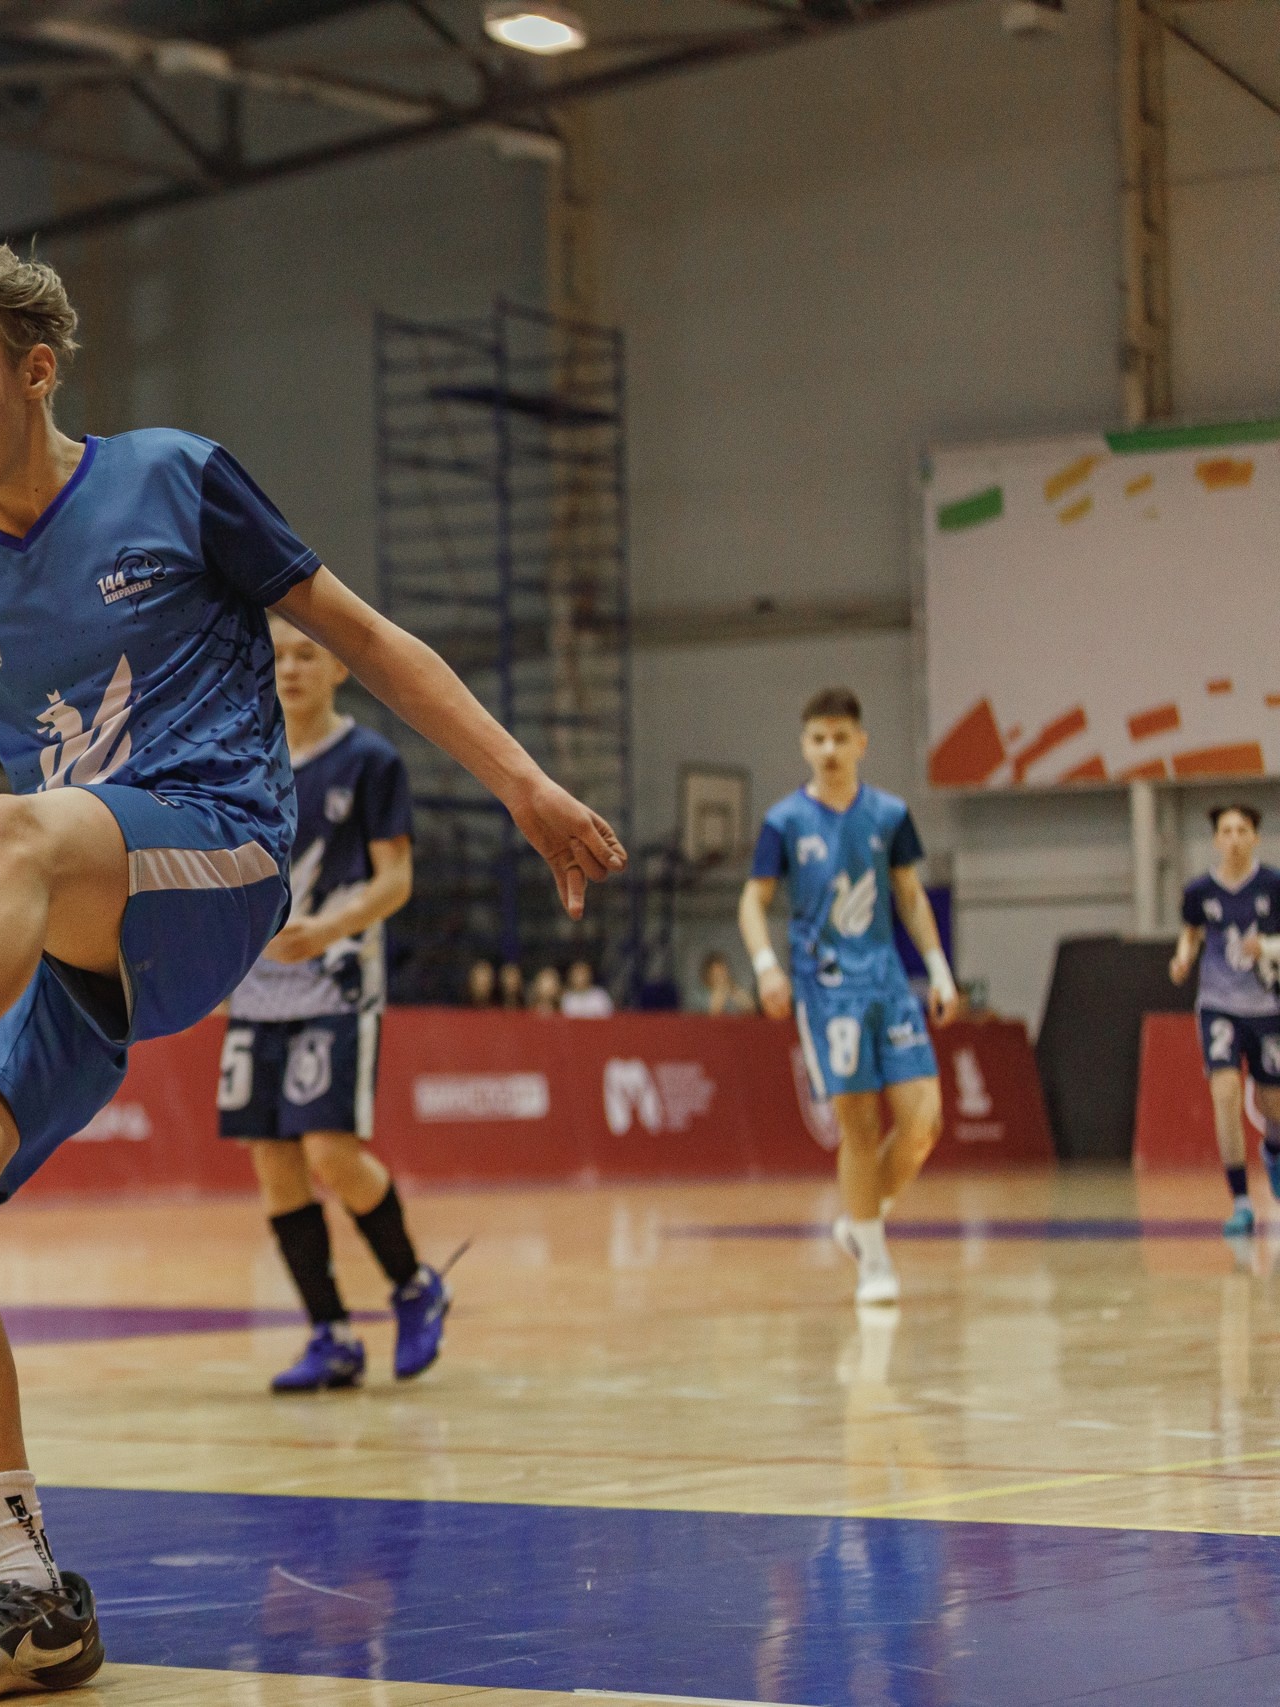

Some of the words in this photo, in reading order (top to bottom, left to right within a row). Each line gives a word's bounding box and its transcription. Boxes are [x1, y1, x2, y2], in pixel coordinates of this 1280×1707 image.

[97, 572, 126, 595] 144
[105, 580, 152, 605] ПИРАНЬИ
[827, 1016, 860, 1077] 8
[1209, 1018, 1235, 1062] 2
[217, 1027, 255, 1112] 5
